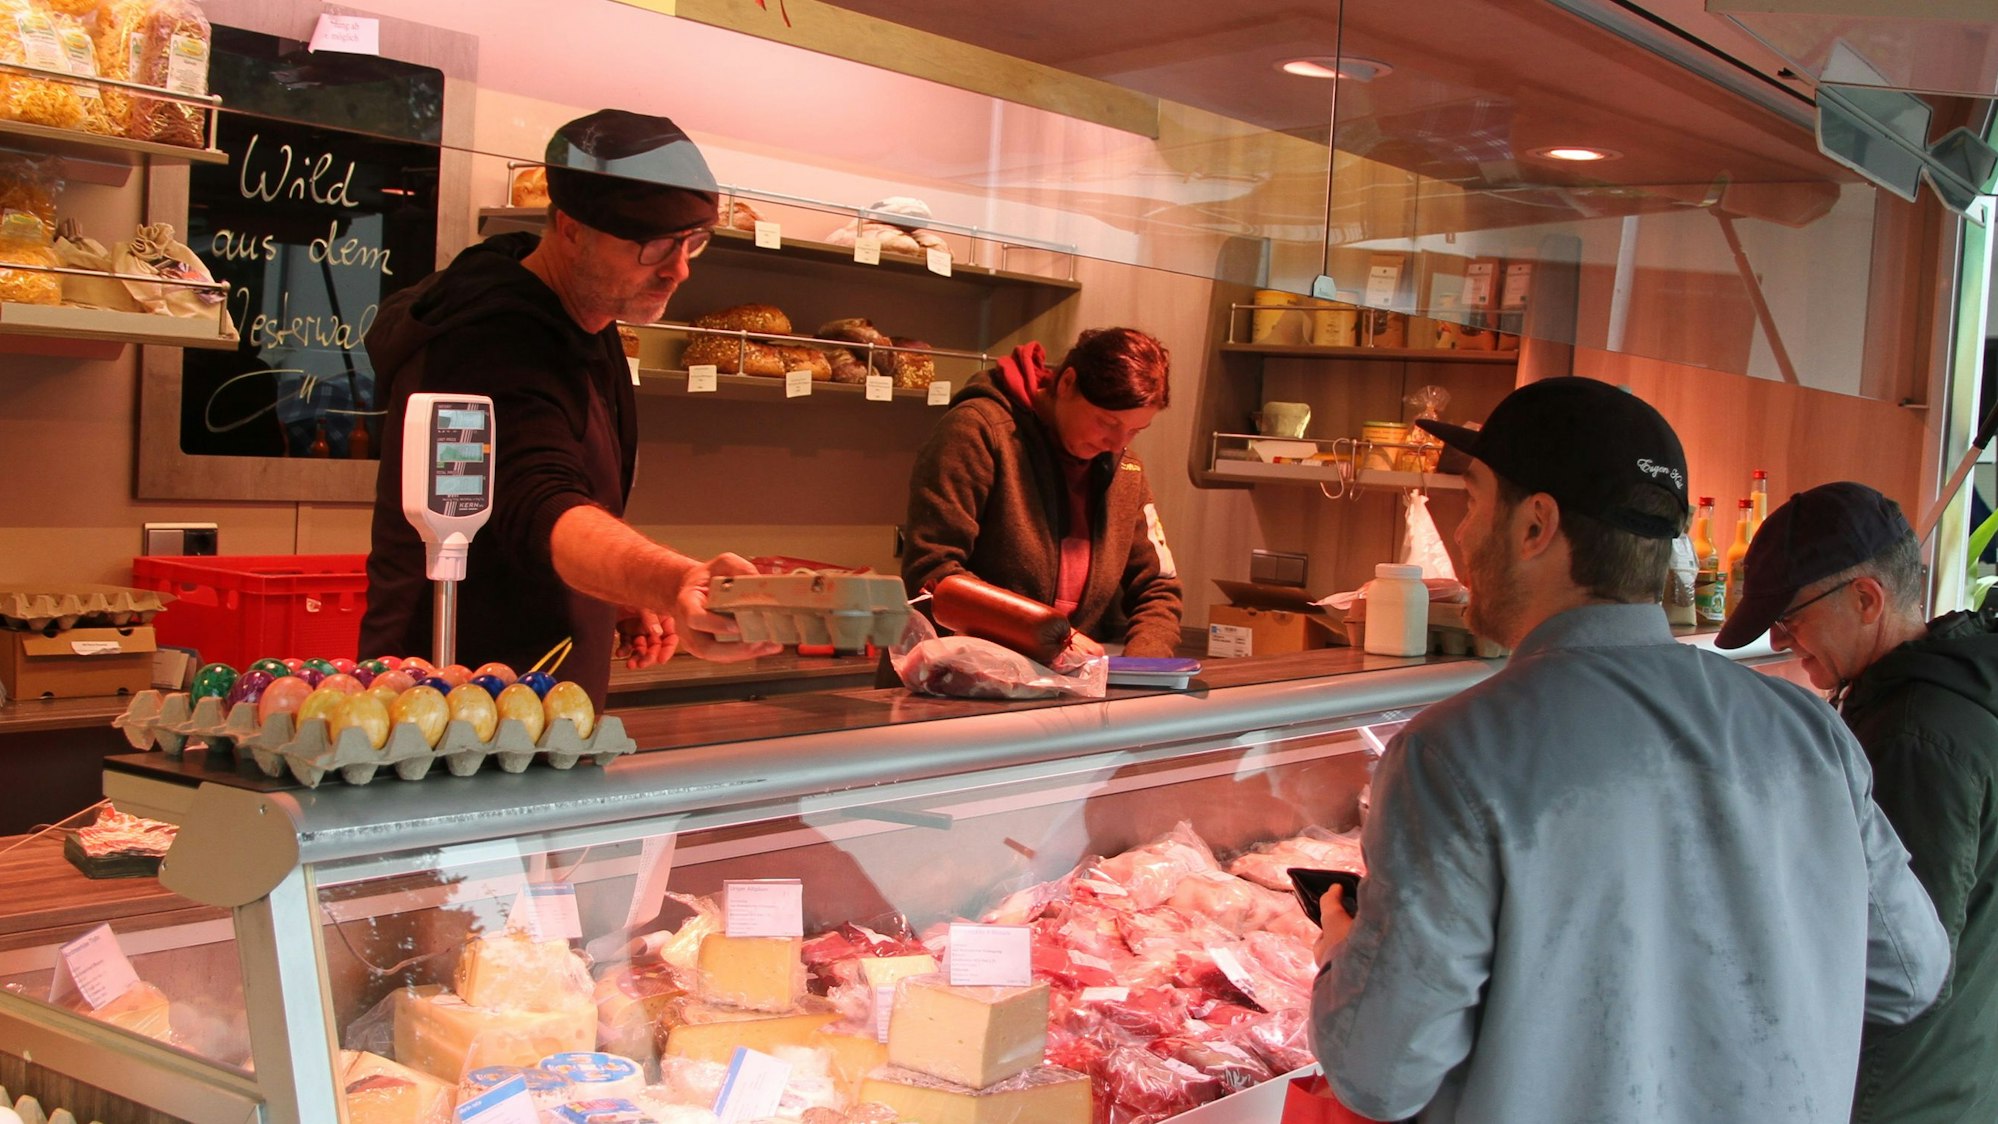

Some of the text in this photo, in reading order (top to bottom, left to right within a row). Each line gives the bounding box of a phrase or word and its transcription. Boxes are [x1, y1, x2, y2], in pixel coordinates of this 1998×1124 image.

[240, 133, 359, 208] Wild
[211, 219, 394, 276] aus dem
[236, 286, 379, 350] esterwal
[459, 501, 480, 509] KERN
